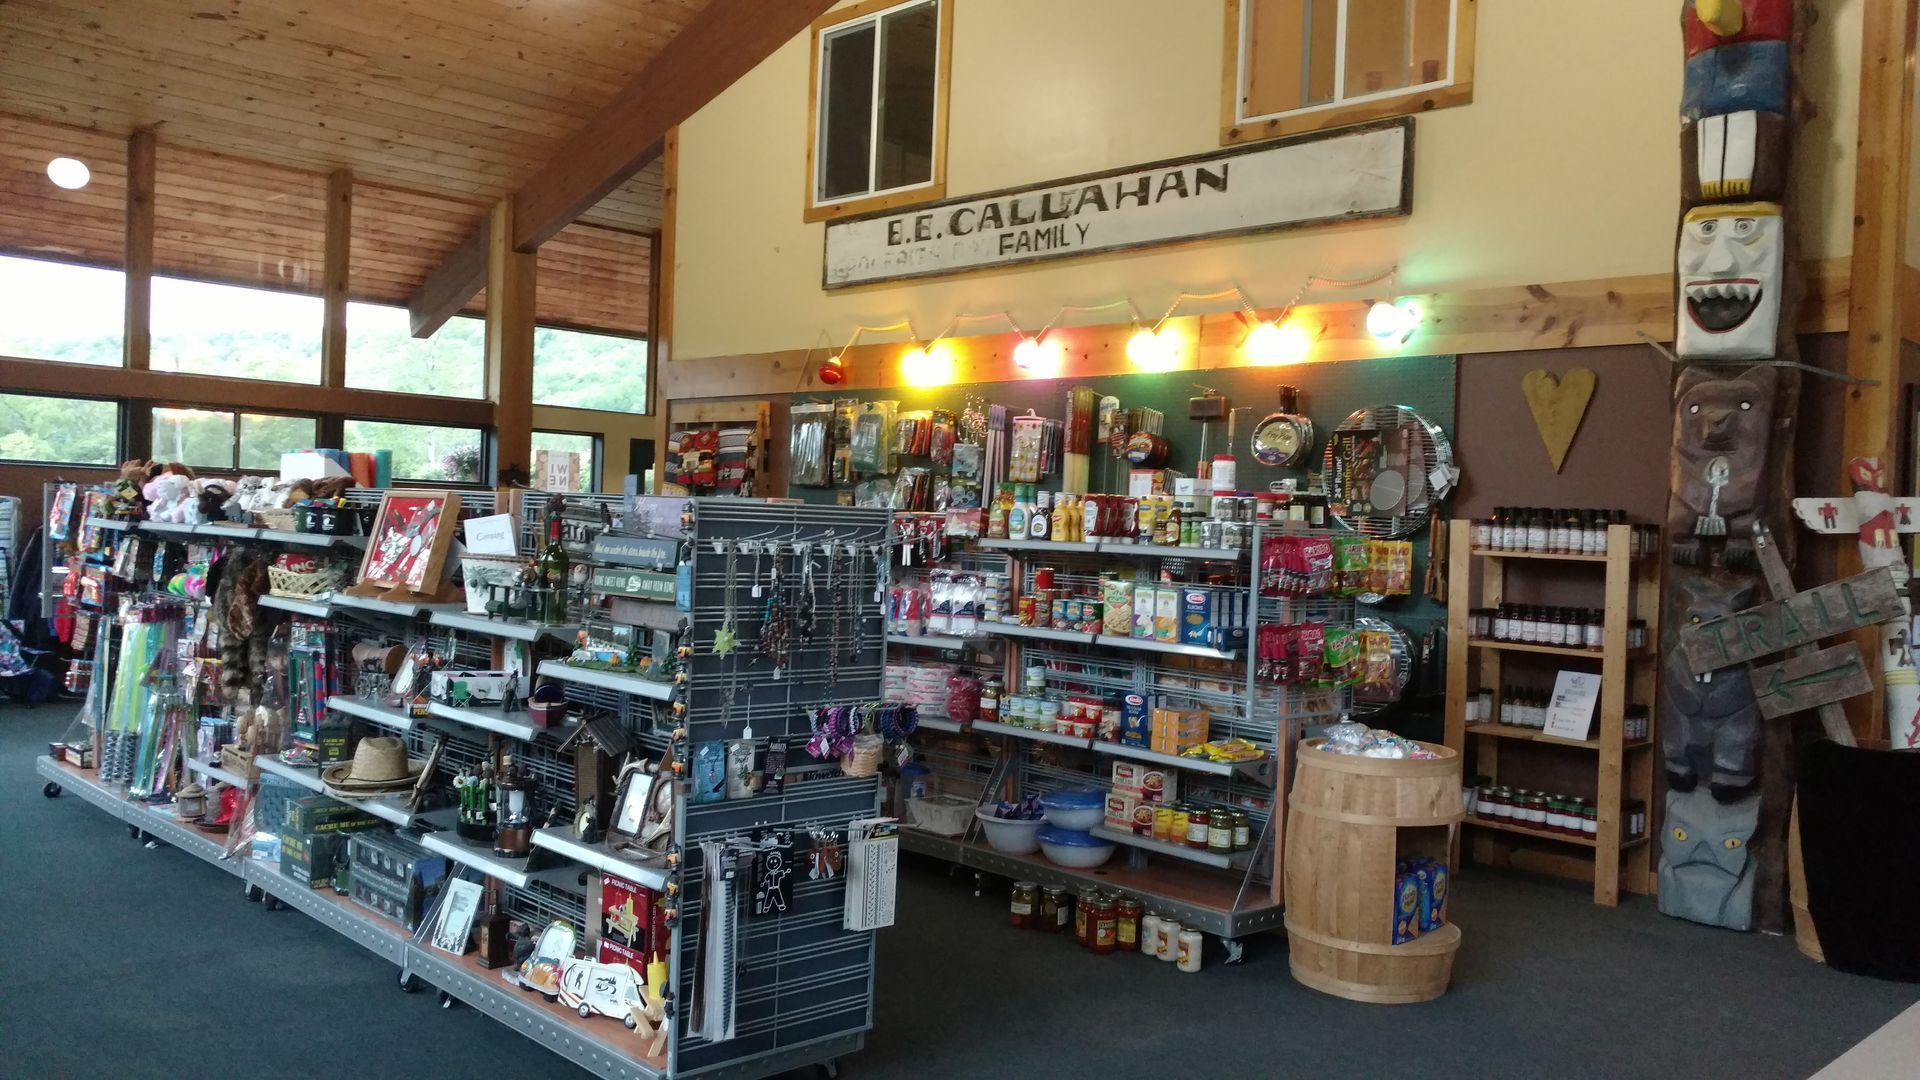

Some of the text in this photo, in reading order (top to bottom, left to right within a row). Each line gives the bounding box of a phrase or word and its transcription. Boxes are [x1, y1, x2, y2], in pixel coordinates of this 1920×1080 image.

[949, 163, 1229, 236] CALLAHAN
[999, 222, 1090, 256] FAMILY
[1334, 456, 1342, 483] Round
[1342, 436, 1352, 508] Campfire Grill
[1698, 582, 1880, 660] TRAIL
[315, 822, 338, 831] CACHE
[611, 878, 637, 894] PICNIC TABLE
[609, 943, 634, 959] PICNIC TABLE
